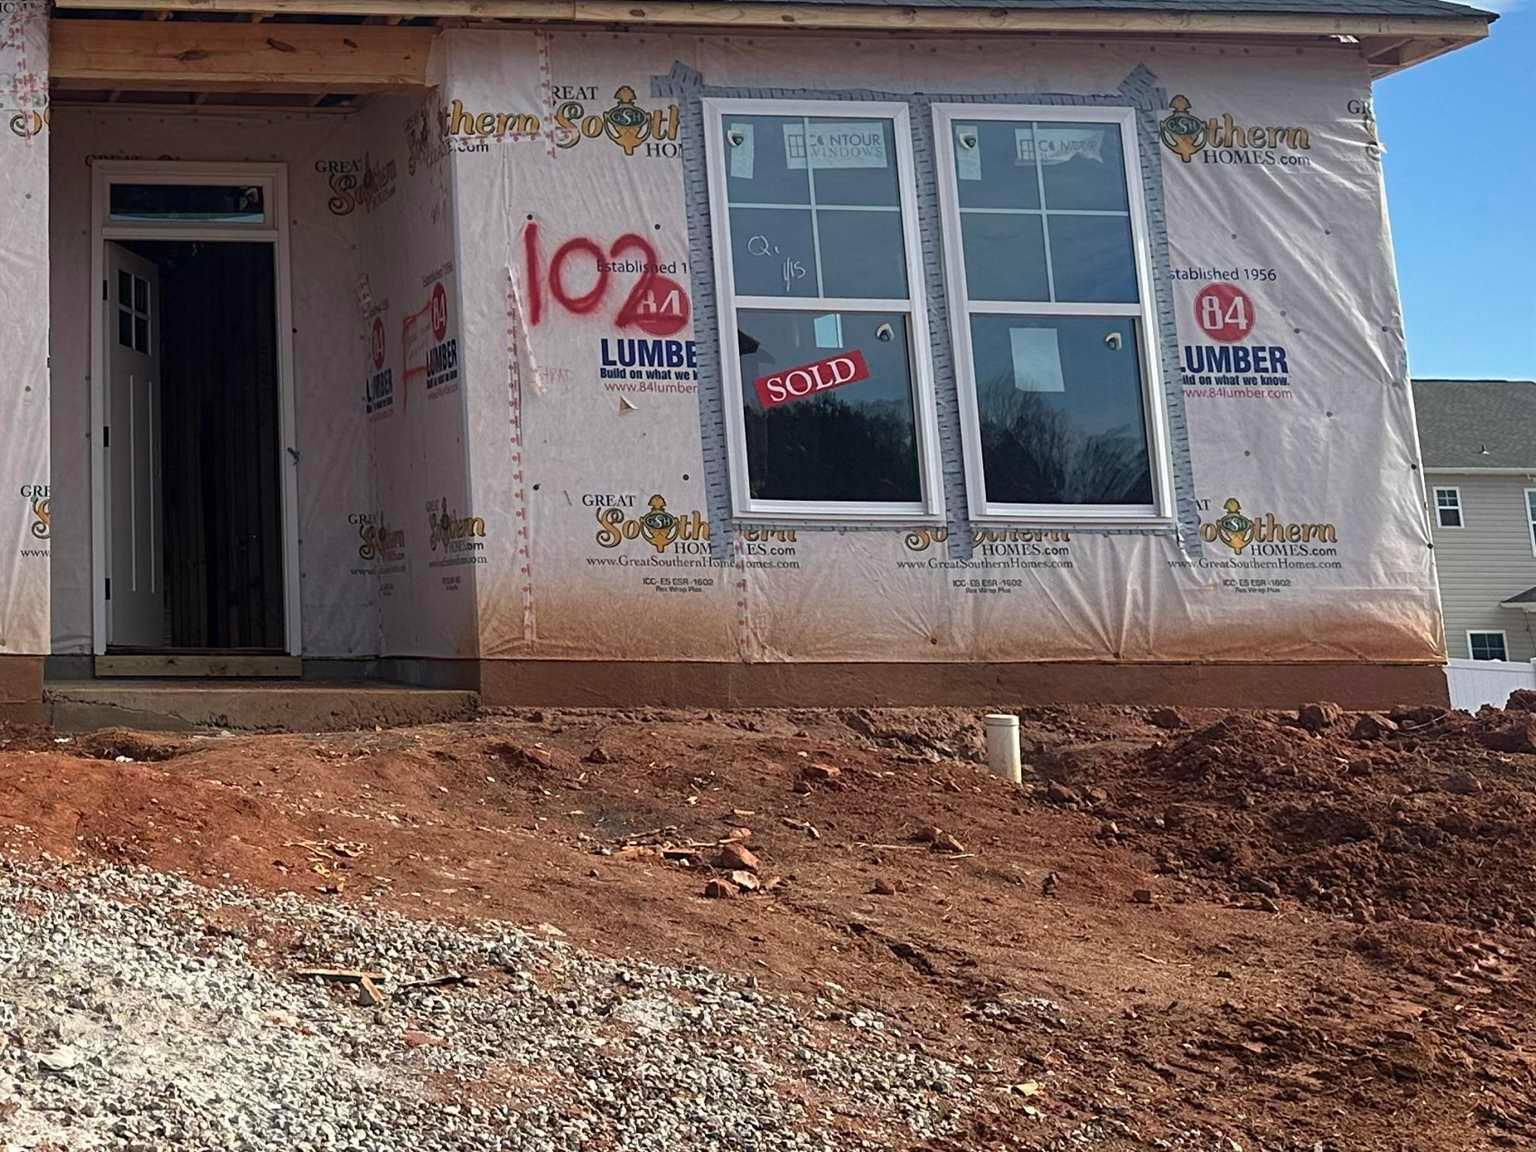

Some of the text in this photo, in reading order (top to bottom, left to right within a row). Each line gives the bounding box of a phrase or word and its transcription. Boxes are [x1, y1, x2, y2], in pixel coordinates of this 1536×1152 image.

[552, 86, 598, 100] REAT
[1202, 150, 1312, 167] HOMES.com
[525, 222, 658, 328] 102
[1244, 269, 1277, 282] 1956
[1201, 295, 1248, 331] 84
[1181, 345, 1290, 375] UMBER
[600, 367, 690, 381] Build on what we
[766, 357, 856, 402] SOLD
[1198, 375, 1291, 387] on what we know.
[582, 494, 637, 507] GREAT
[982, 543, 1069, 556] HOMES.com
[1250, 544, 1337, 557] HOMES.com
[1168, 557, 1342, 570] www.GreatSouthernHomes.com
